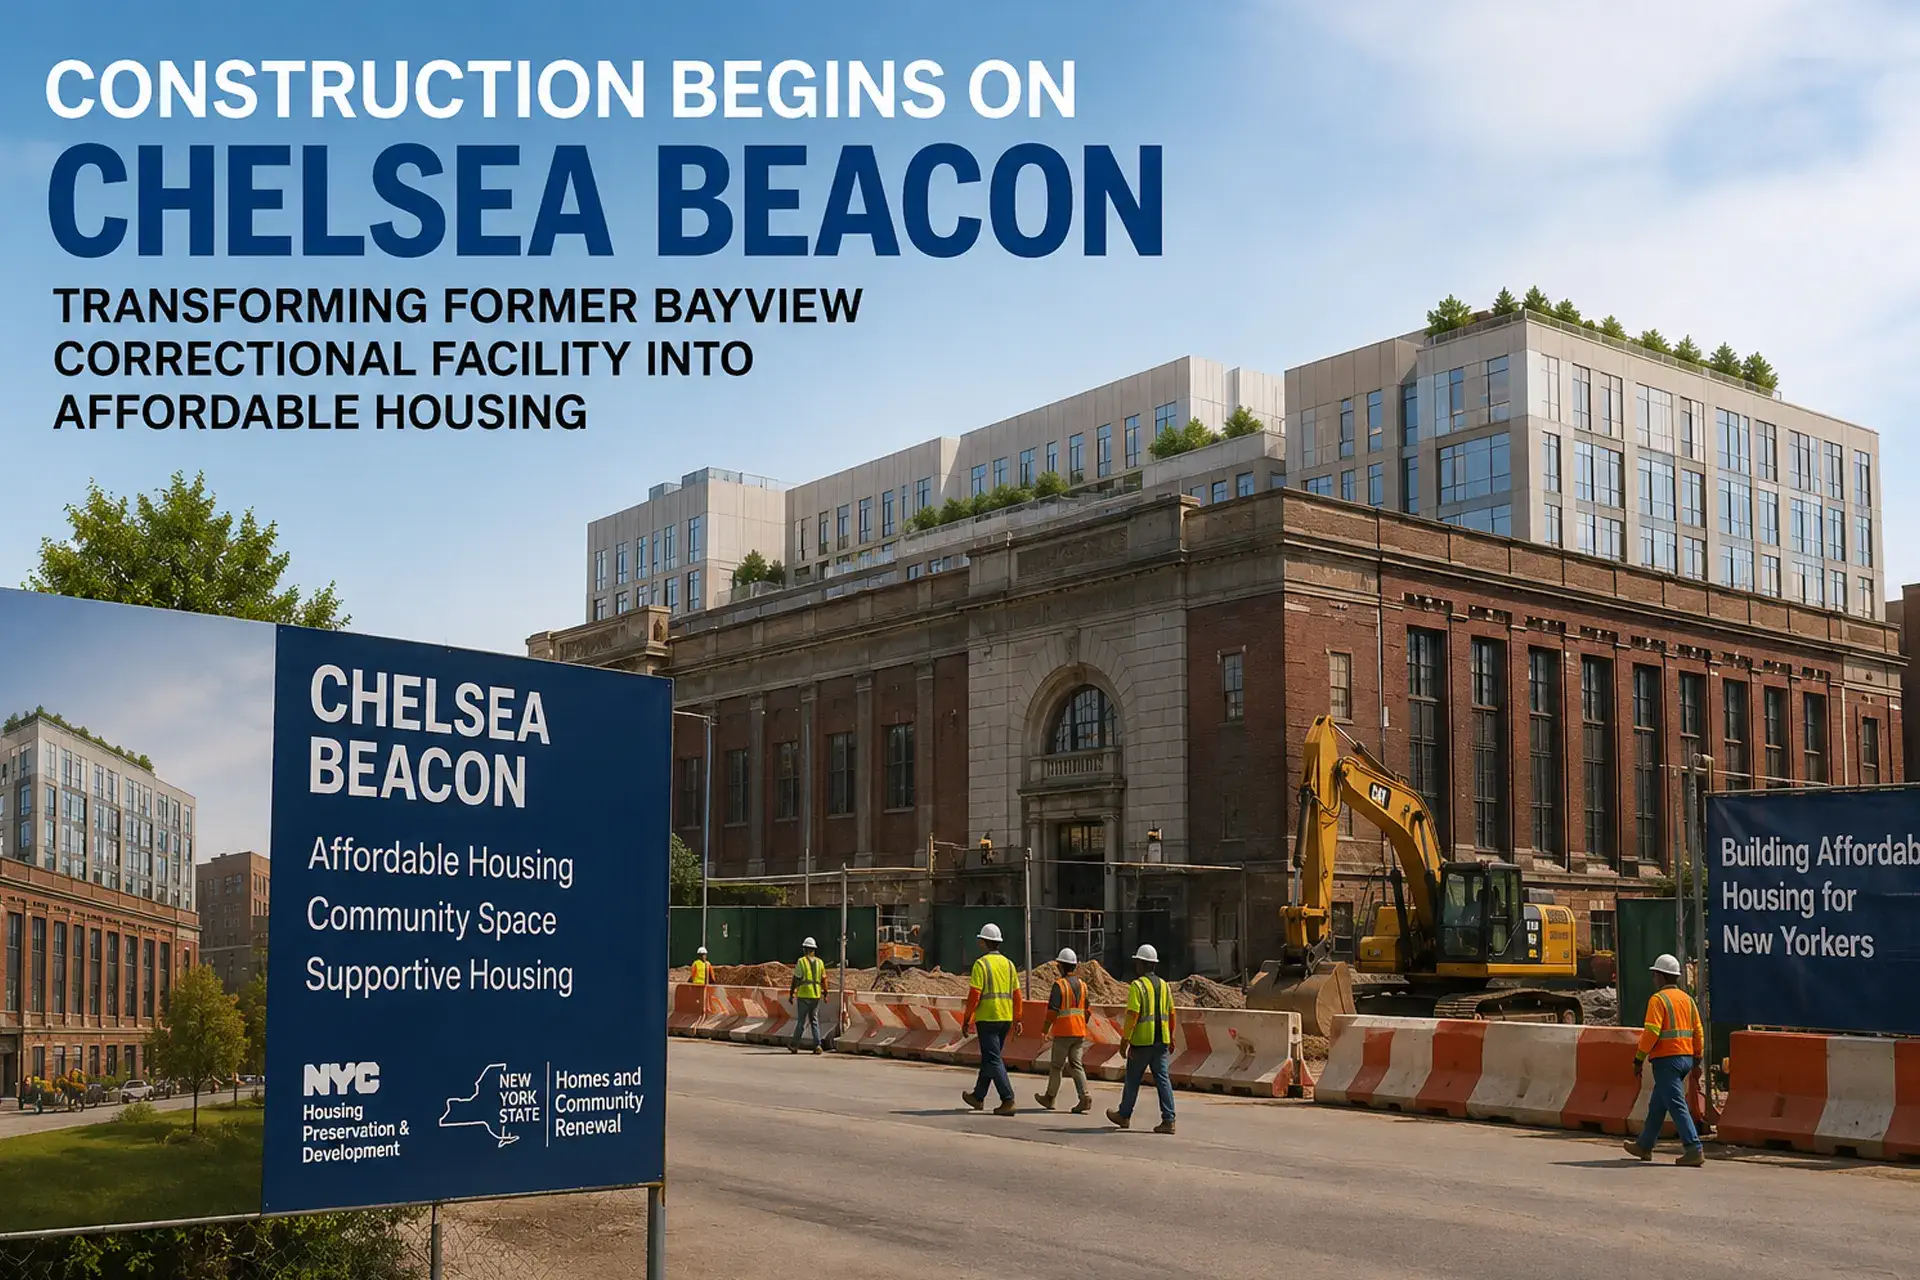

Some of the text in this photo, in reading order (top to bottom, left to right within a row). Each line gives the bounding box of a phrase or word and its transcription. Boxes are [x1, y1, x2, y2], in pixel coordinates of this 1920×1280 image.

[311, 664, 550, 744] CHELSEA
[310, 736, 525, 808] BEACON
[1371, 784, 1387, 807] CAT
[309, 837, 572, 888] Affordable Housing
[1722, 834, 1920, 873] Building Affordab
[1723, 881, 1857, 918] Housing for
[308, 896, 556, 941] Community Space
[1724, 925, 1874, 957] New Yorkers
[306, 957, 572, 998] Supportive Housing
[304, 1062, 379, 1096] NYC
[500, 1073, 531, 1088] NEW
[557, 1067, 641, 1089] Homes and
[500, 1090, 536, 1106] YORK
[556, 1091, 643, 1113] Community
[304, 1102, 363, 1121] Housing
[500, 1107, 539, 1123] STATE
[303, 1120, 409, 1141] Preservation &
[556, 1113, 621, 1137] Renewal
[303, 1141, 400, 1163] Development
